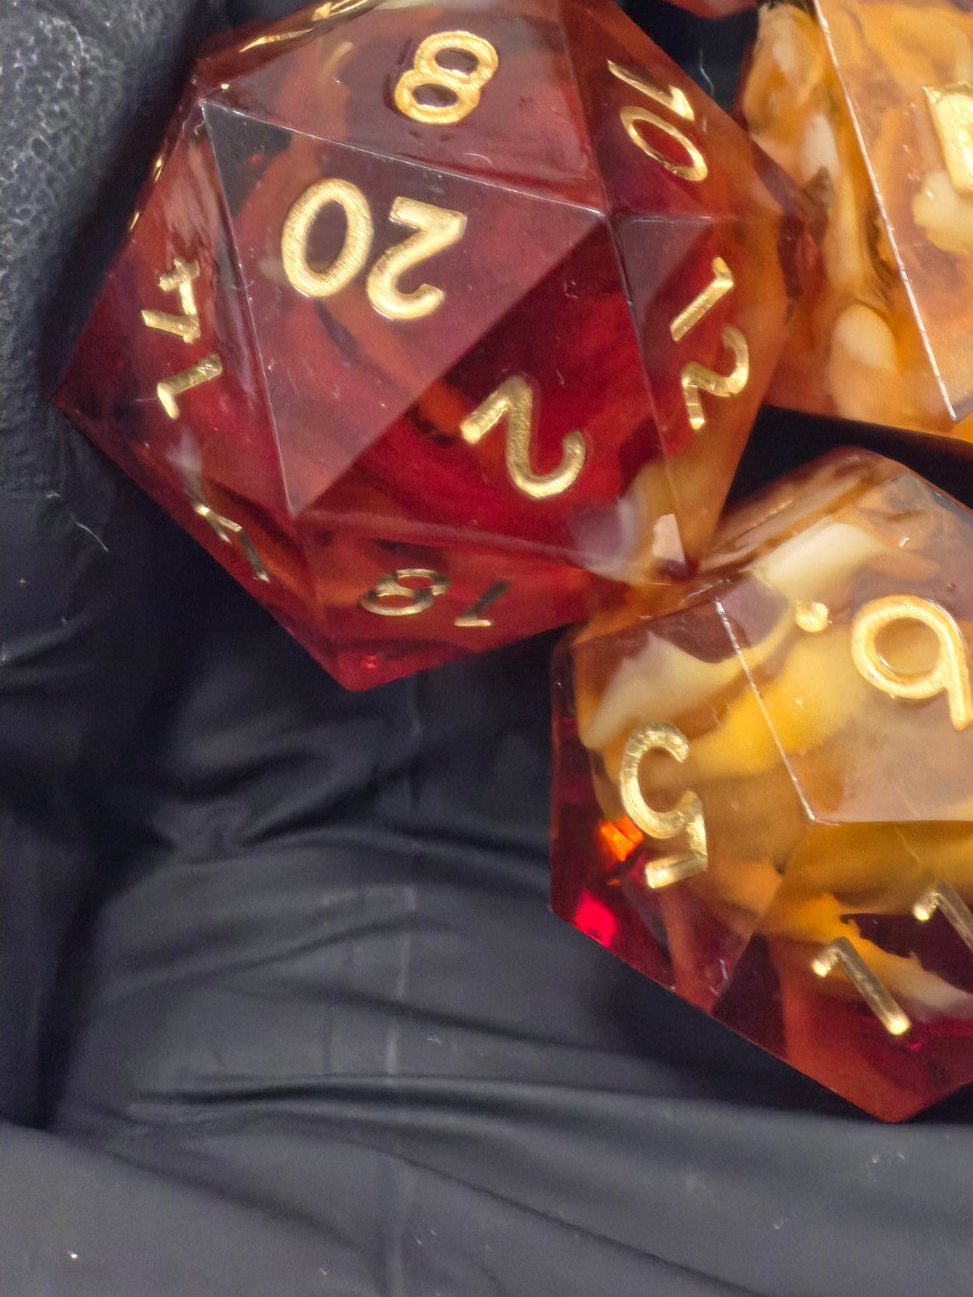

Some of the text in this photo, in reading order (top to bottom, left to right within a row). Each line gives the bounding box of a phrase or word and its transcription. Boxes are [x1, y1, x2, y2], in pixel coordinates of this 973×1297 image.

[394, 30, 499, 124] 8
[608, 59, 709, 181] 10
[281, 177, 468, 320] 20
[669, 255, 750, 430] 12
[459, 374, 588, 499] 2
[619, 720, 708, 890] 5
